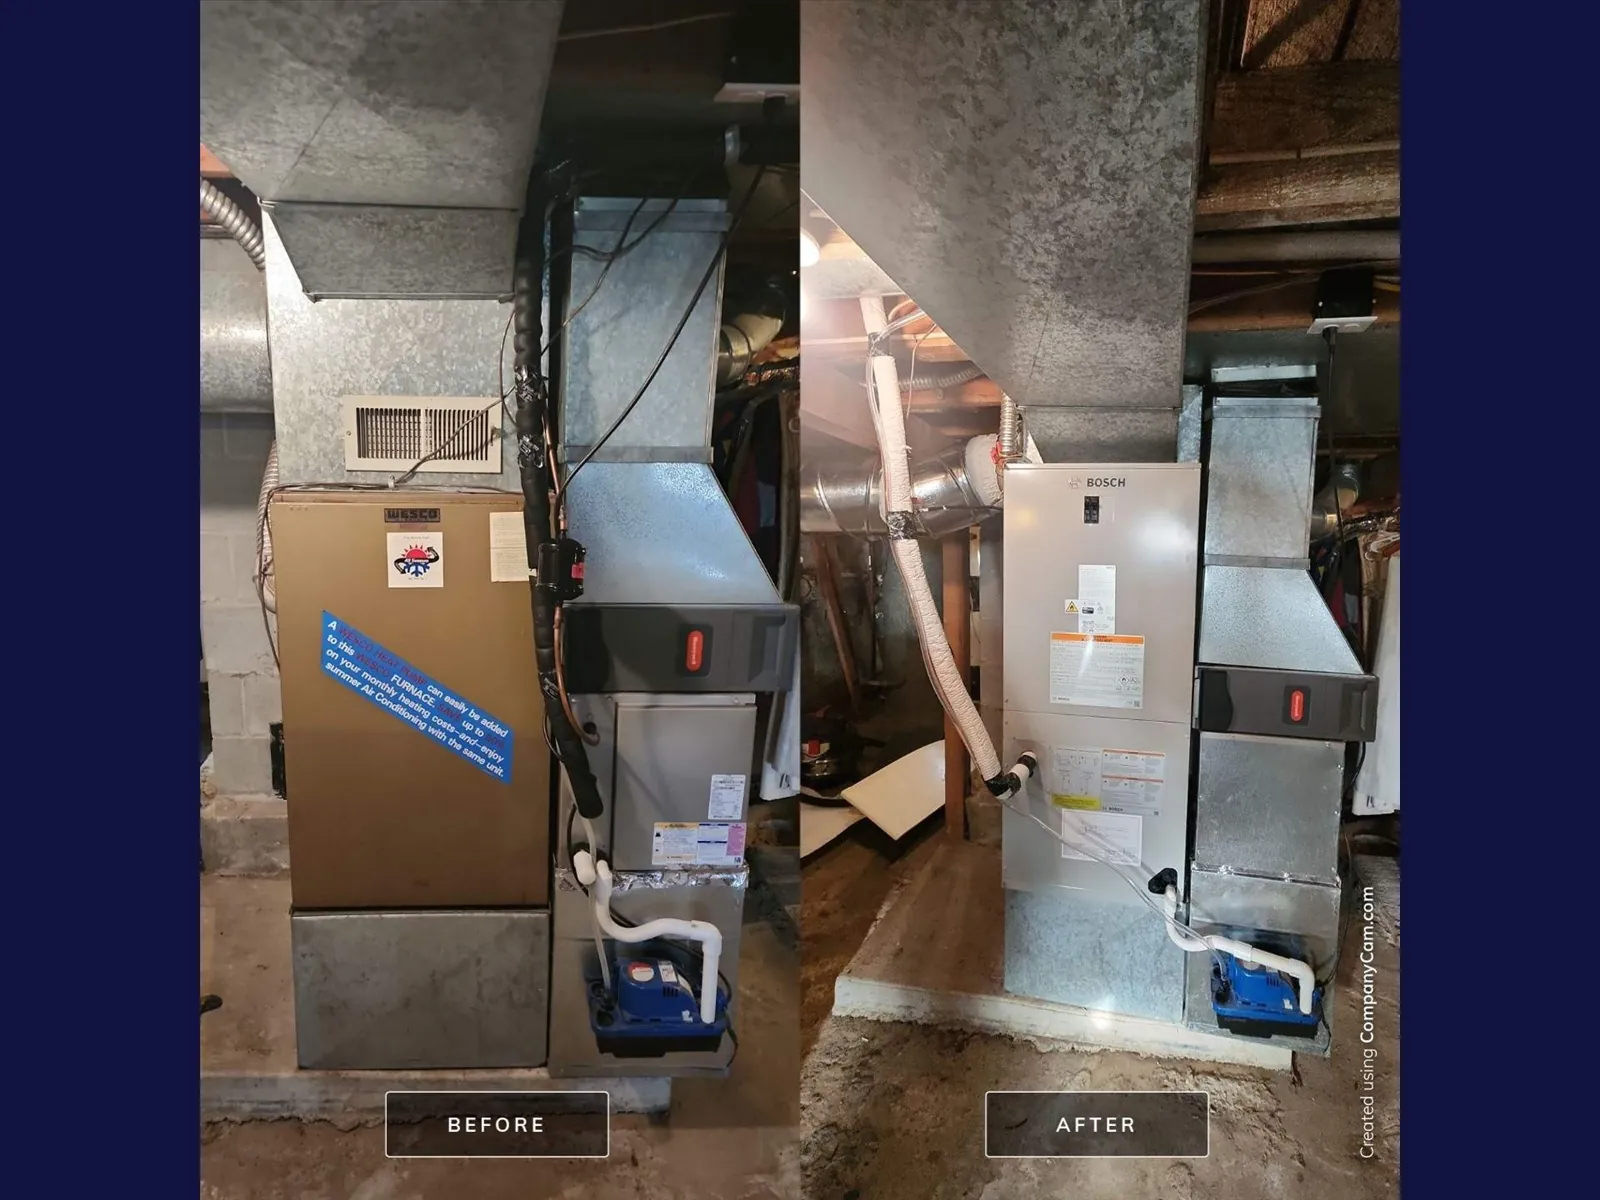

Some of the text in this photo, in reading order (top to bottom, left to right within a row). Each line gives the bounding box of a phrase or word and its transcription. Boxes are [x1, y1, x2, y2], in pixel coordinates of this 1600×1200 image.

[387, 509, 438, 519] WESCO
[1086, 477, 1126, 488] BOSCH
[325, 662, 504, 777] summer Air Conditioning with the same unit.
[326, 649, 339, 660] on
[339, 657, 361, 674] your
[361, 671, 398, 698] monthly
[398, 692, 431, 719] heating
[327, 620, 338, 631] A
[427, 684, 444, 698] can
[444, 695, 469, 714] easily
[468, 708, 481, 721] be
[480, 718, 509, 738] added
[327, 634, 338, 645] to
[338, 640, 355, 656] this
[390, 674, 436, 708] FURNACE.
[461, 720, 474, 731] up
[474, 727, 485, 738] to
